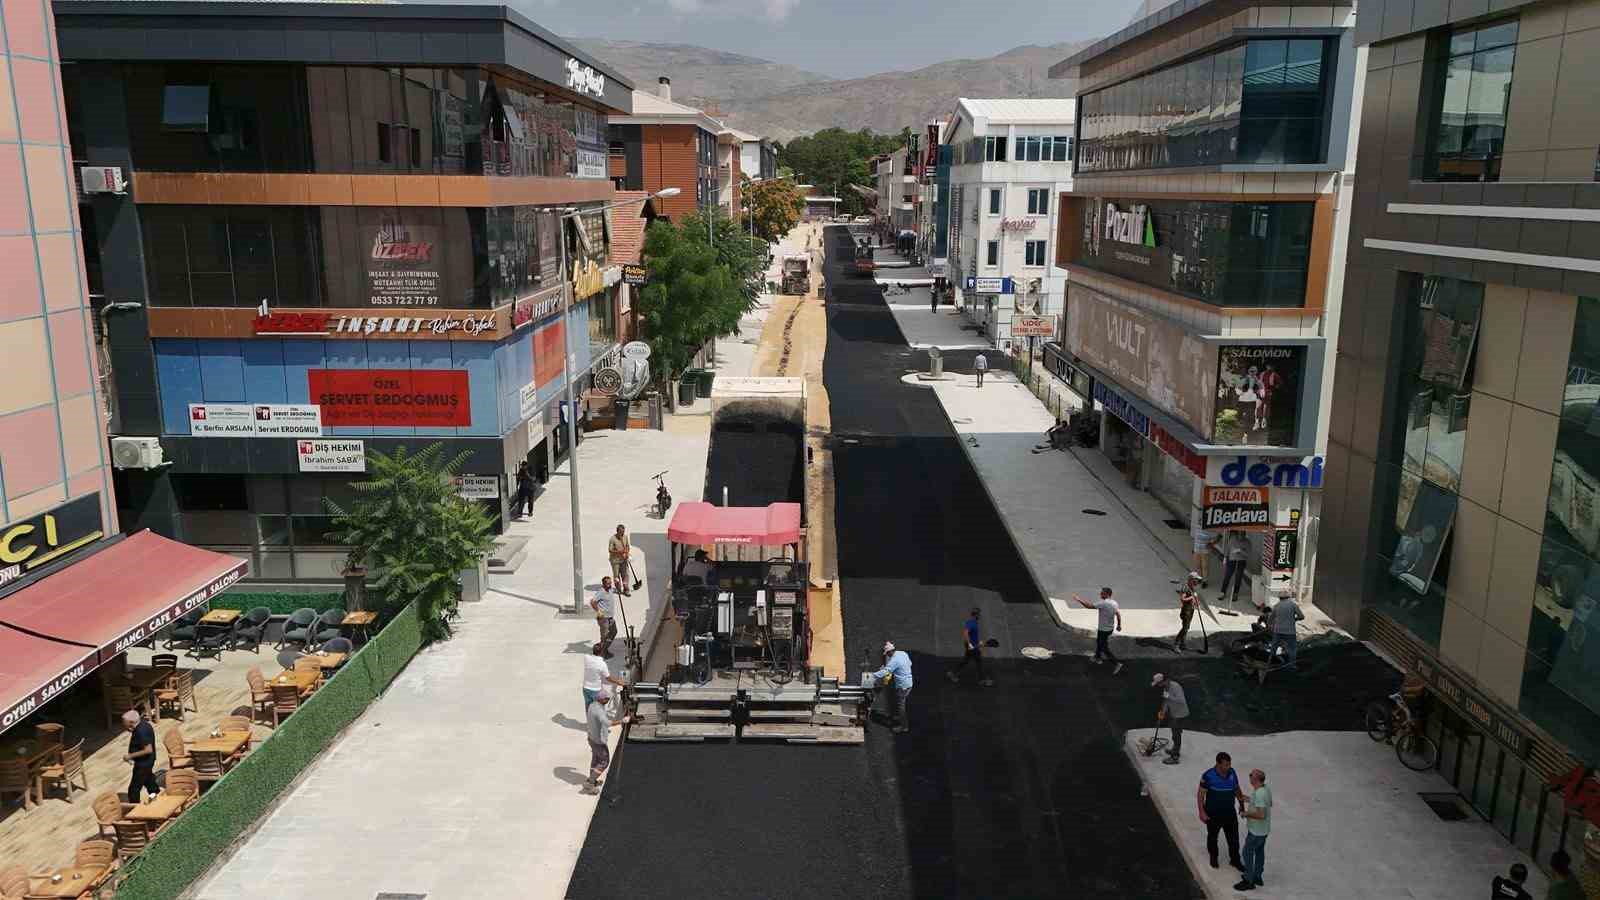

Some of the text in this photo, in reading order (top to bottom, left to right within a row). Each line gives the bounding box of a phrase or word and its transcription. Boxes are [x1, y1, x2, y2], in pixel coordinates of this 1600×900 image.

[371, 296, 438, 305] 0533 722 77 97
[1231, 349, 1292, 358] SALOMON
[374, 377, 400, 388] ÖZEL
[319, 394, 369, 405] SERVET
[225, 424, 253, 432] ARSLAN
[315, 443, 329, 453] DİŞ
[1205, 507, 1268, 525] 1Bedava
[149, 612, 171, 634] CAFE
[174, 606, 182, 617] &
[185, 592, 207, 609] OYUN
[210, 571, 239, 595] SALONU
[2, 665, 84, 726] OYUN SALONU
